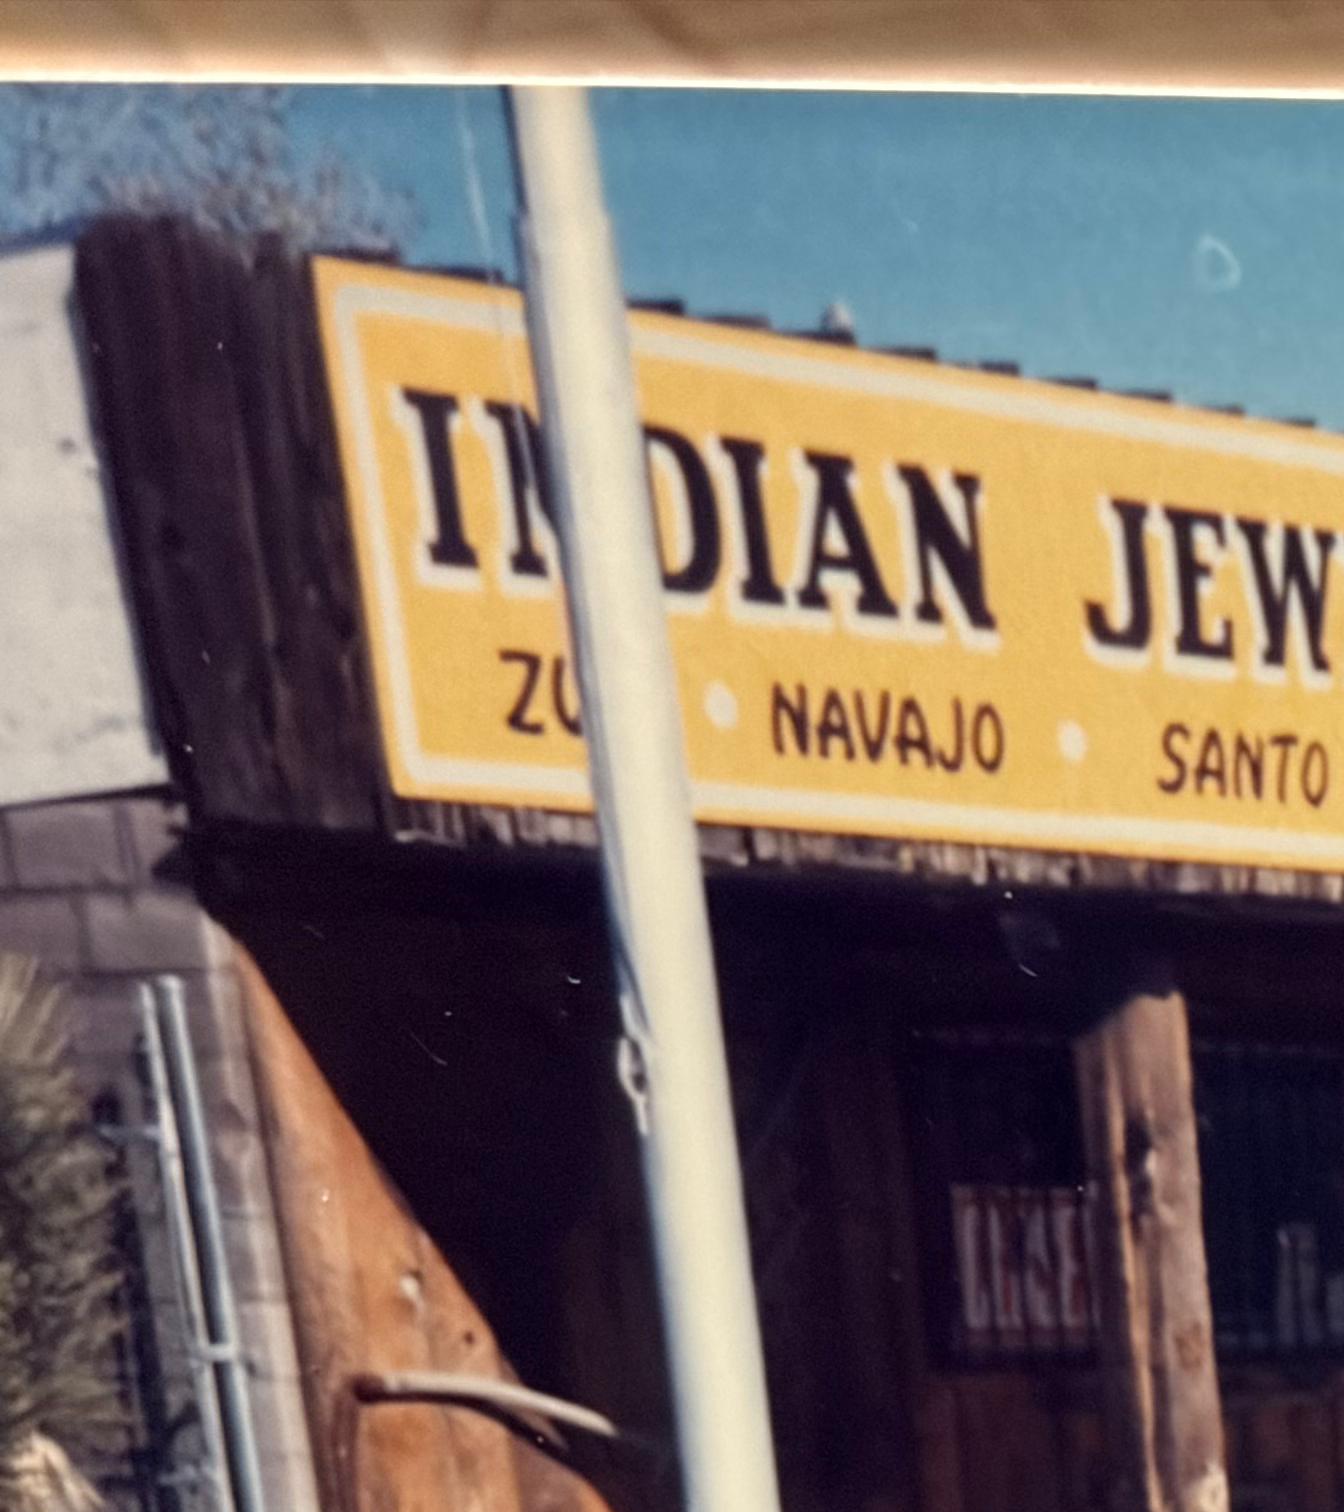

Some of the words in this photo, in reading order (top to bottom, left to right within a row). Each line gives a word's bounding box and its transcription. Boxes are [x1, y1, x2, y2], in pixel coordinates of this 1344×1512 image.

[498, 648, 585, 737] ZU
[770, 681, 1006, 775] NAVAJO
[1156, 721, 1329, 808] SANTO
